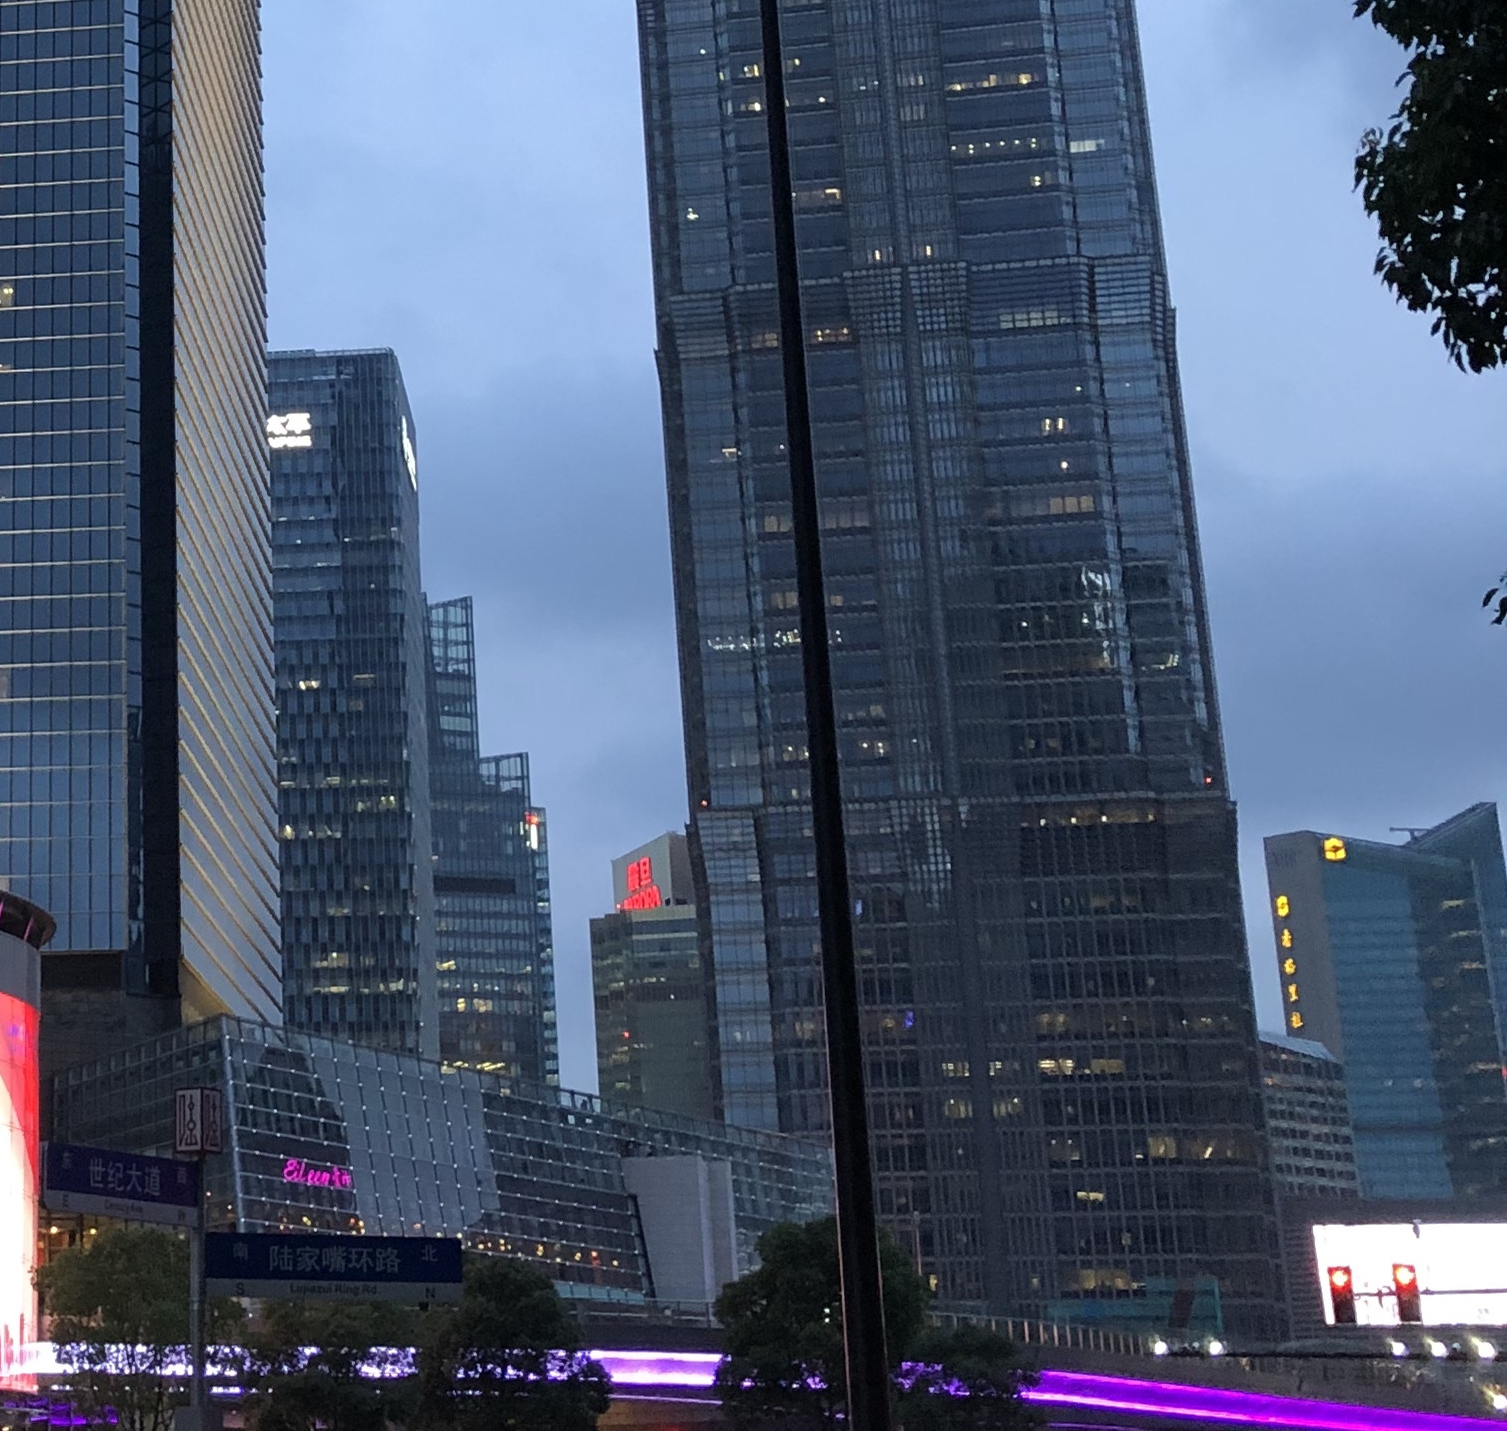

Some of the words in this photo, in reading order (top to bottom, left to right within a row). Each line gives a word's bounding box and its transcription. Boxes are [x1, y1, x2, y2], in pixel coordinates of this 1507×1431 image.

[88, 1157, 162, 1197] 世纪大道
[268, 1245, 402, 1274] 陆家嘴环路
[421, 1244, 439, 1263] 北
[235, 1283, 245, 1297] S
[424, 1287, 436, 1300] N
